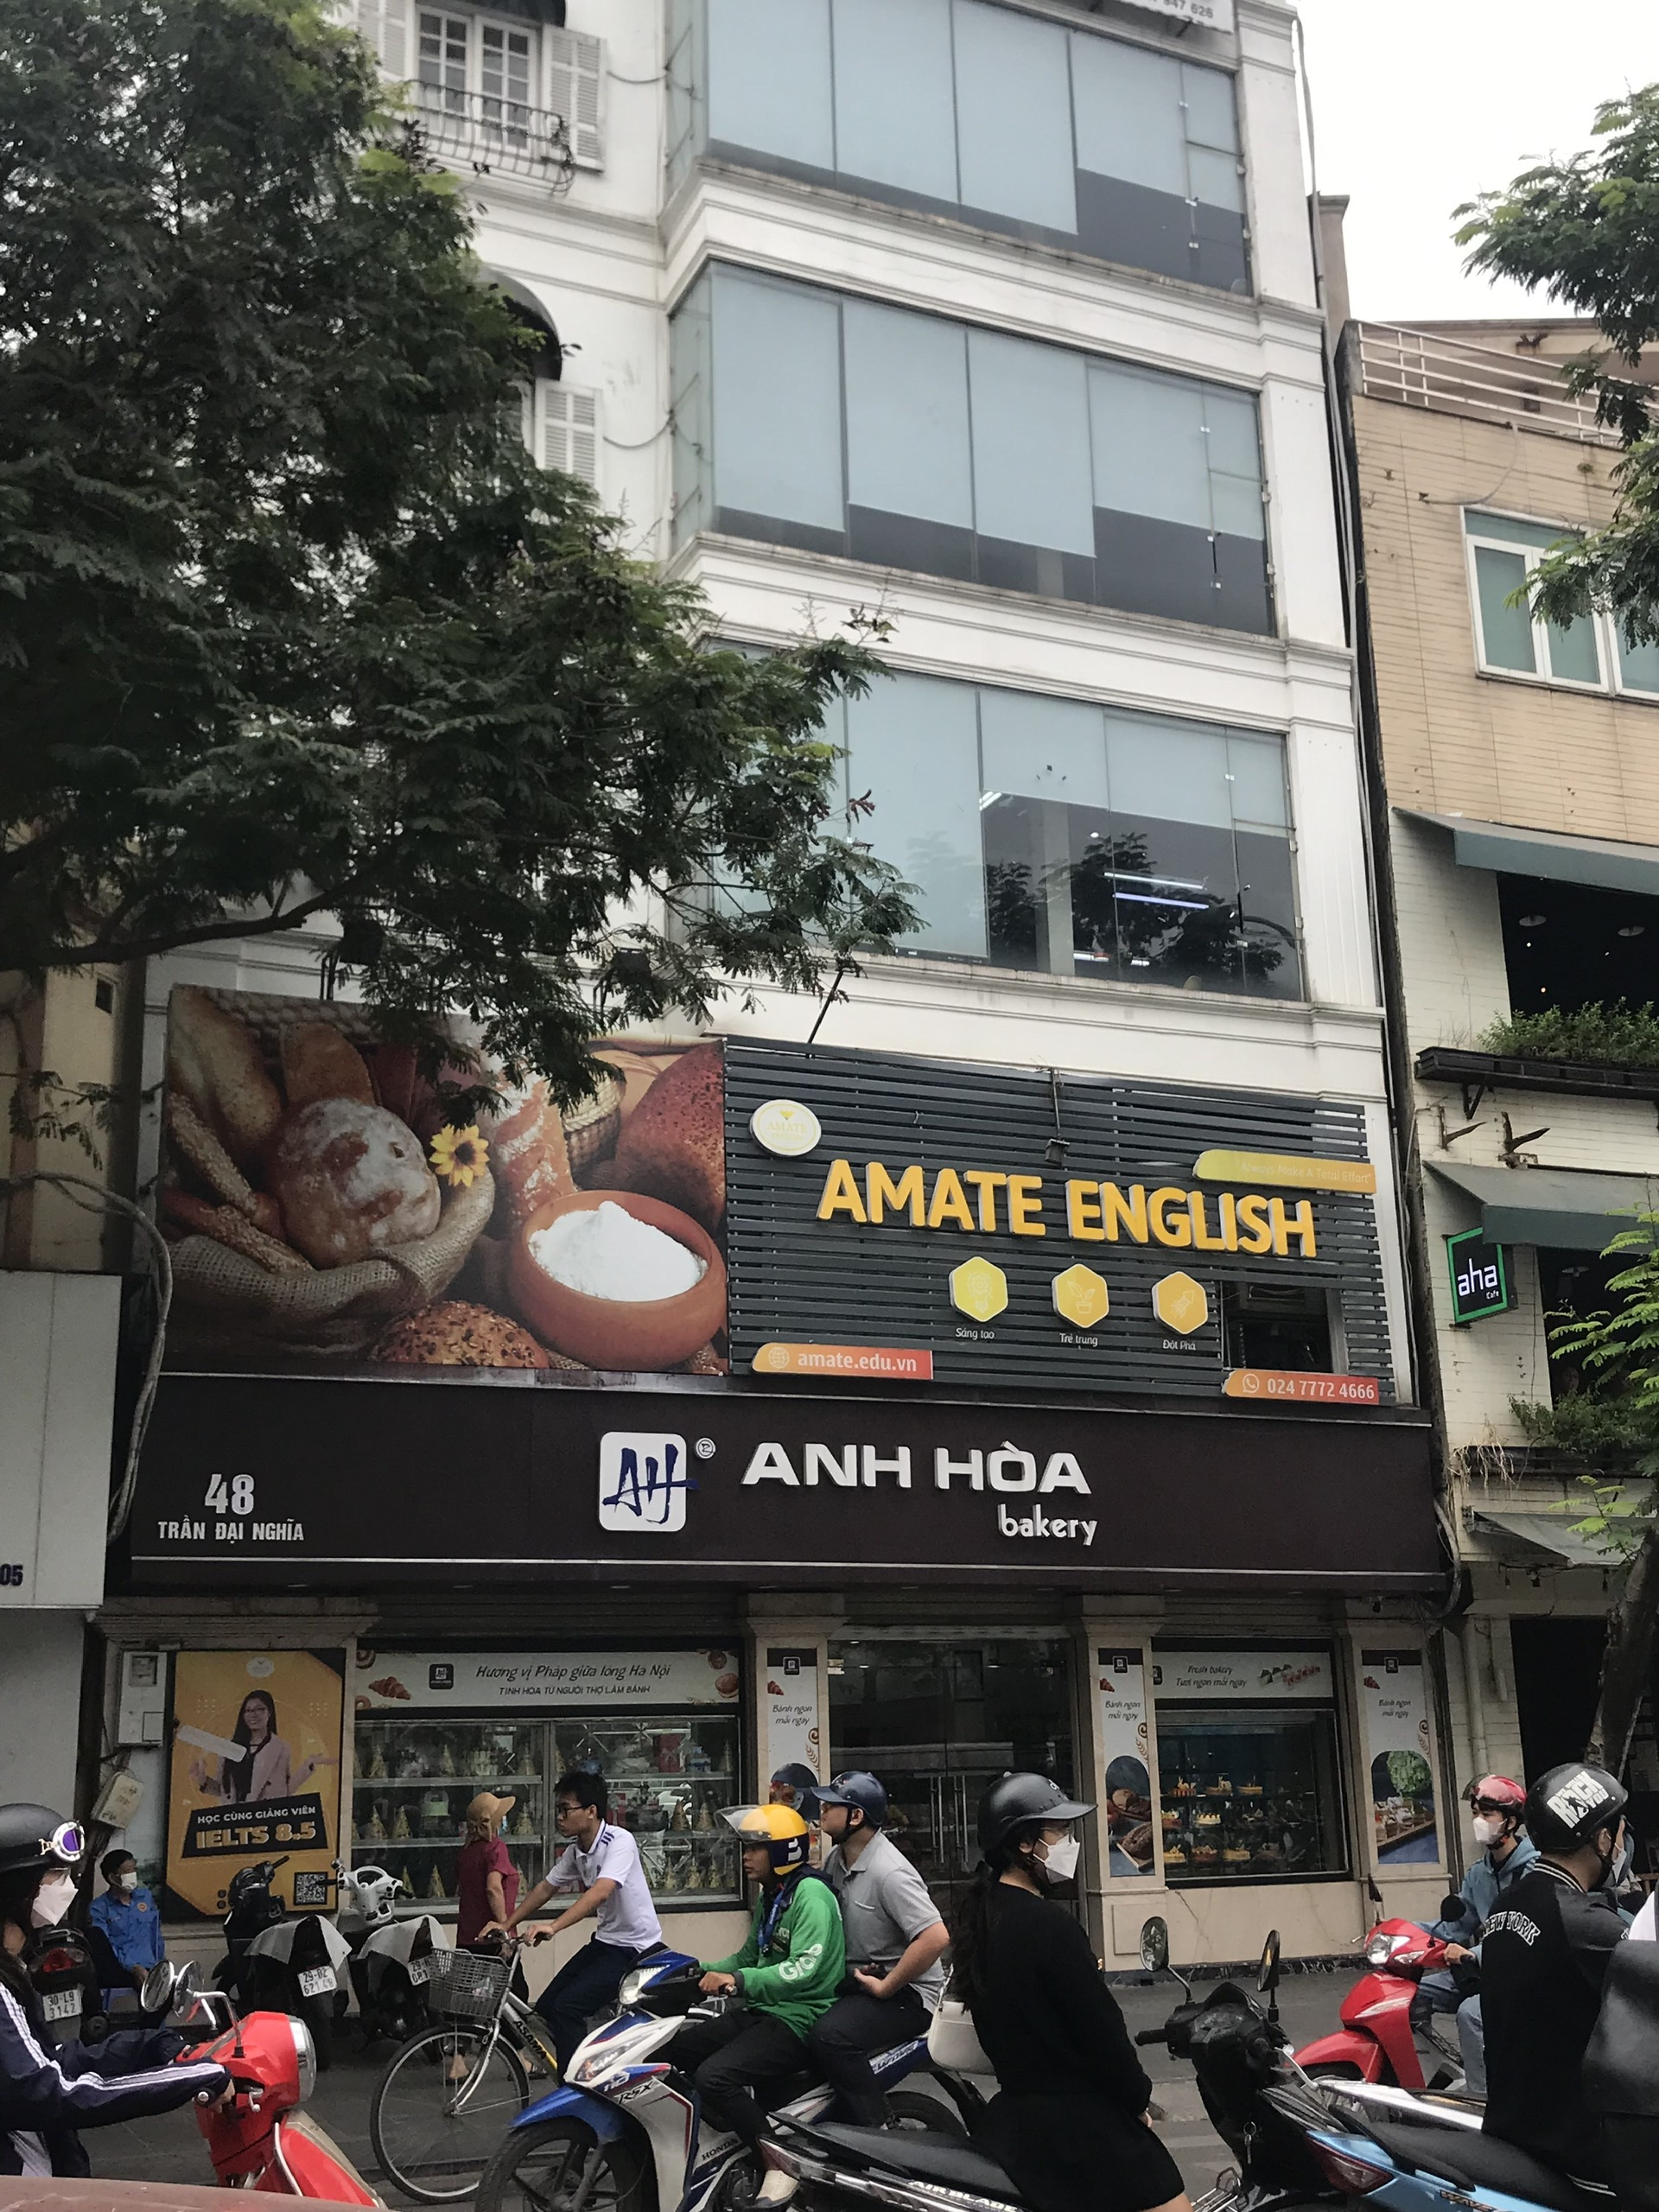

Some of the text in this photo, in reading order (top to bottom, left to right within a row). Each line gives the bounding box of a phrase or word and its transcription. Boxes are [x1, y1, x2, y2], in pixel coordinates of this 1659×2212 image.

[1278, 1165, 1303, 1177] Make
[1306, 1166, 1313, 1177] A
[1316, 1168, 1340, 1180] Total
[817, 1159, 1317, 1258] AMATE ENGLISH
[1458, 1257, 1499, 1297] aha
[956, 1327, 978, 1340] Sáng
[1076, 1334, 1098, 1347] trung
[798, 1352, 917, 1372] amate.edu.vn
[1268, 1378, 1375, 1399] 024 7772 4666
[741, 1440, 1092, 1494] ANH HÒA
[205, 1473, 255, 1515] 48
[158, 1515, 304, 1544] TRẦN ĐẠI NGHĨA
[997, 1503, 1097, 1546] bakery
[521, 1664, 533, 1681] vị
[535, 1664, 568, 1681] Pháp
[569, 1664, 596, 1681] giữa
[650, 1663, 671, 1679] Nội
[1188, 1665, 1233, 1675] Fresh bakery
[499, 1687, 519, 1695] TINH
[522, 1687, 541, 1695] HOA
[626, 1685, 650, 1694] BÁNH
[1193, 1679, 1212, 1688] ngon
[772, 1704, 812, 1714] Bánh ngon
[1586, 1788, 1609, 1808] YOU
[197, 1804, 316, 1825] HỌC CÙNG GIẢNG VIÊN
[196, 1826, 270, 1849] IELTS
[1506, 1911, 1541, 1946] YORK
[779, 1943, 823, 1980] Grab
[513, 2020, 546, 2060] ASAMA
[702, 2138, 738, 2160] HONDA
